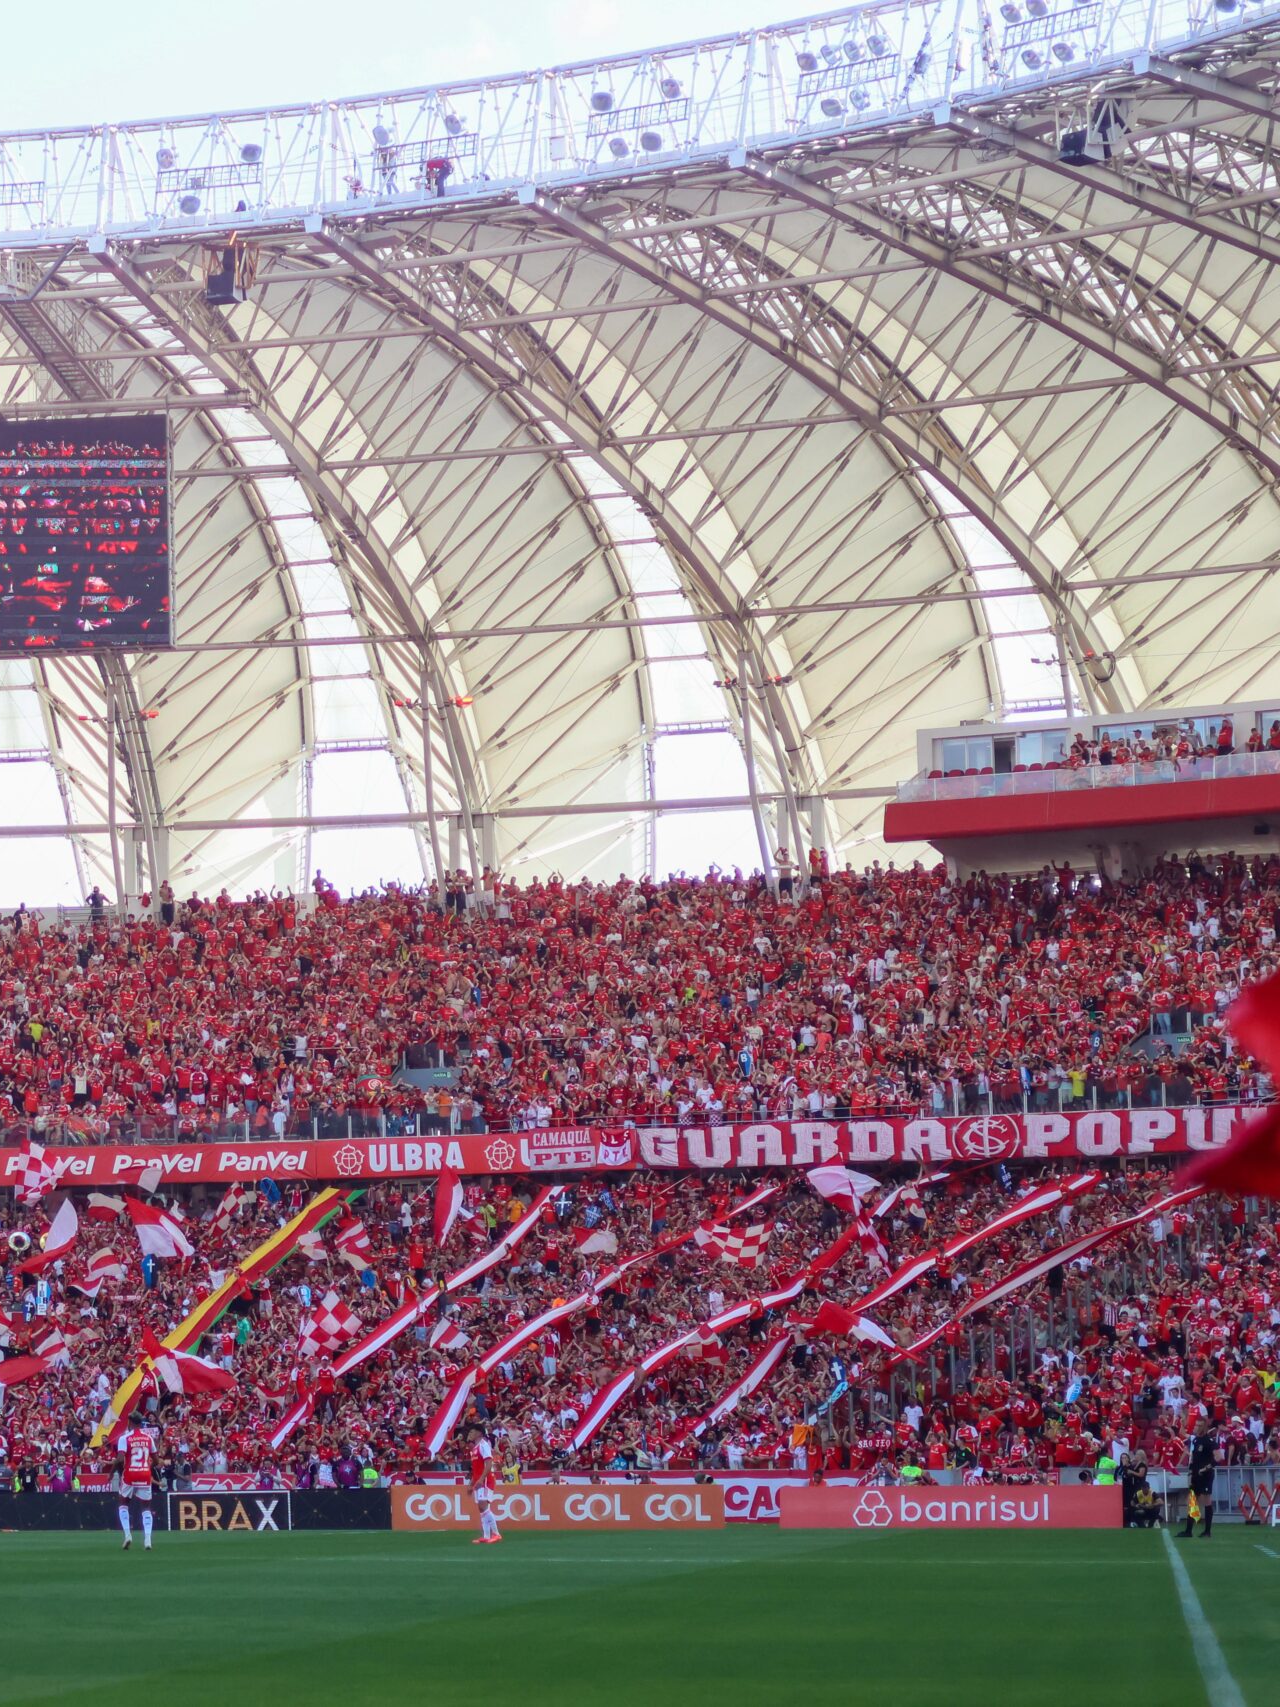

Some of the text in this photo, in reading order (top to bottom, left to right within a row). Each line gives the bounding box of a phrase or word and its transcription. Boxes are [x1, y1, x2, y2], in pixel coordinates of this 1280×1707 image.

[532, 1128, 591, 1146] CAMAQUÃ
[637, 1120, 952, 1168] GUARDA
[1023, 1107, 1267, 1157] POPU
[4, 1155, 96, 1176] PVel
[218, 1151, 308, 1172] PanVel
[368, 1141, 464, 1172] ULBRA
[533, 1150, 592, 1166] PTE
[131, 1447, 149, 1467] 21
[179, 1500, 279, 1531] BRAX
[405, 1494, 470, 1521] GOL
[564, 1494, 630, 1521] GOL
[644, 1494, 711, 1521] GOL
[900, 1493, 1049, 1521] banrisul
